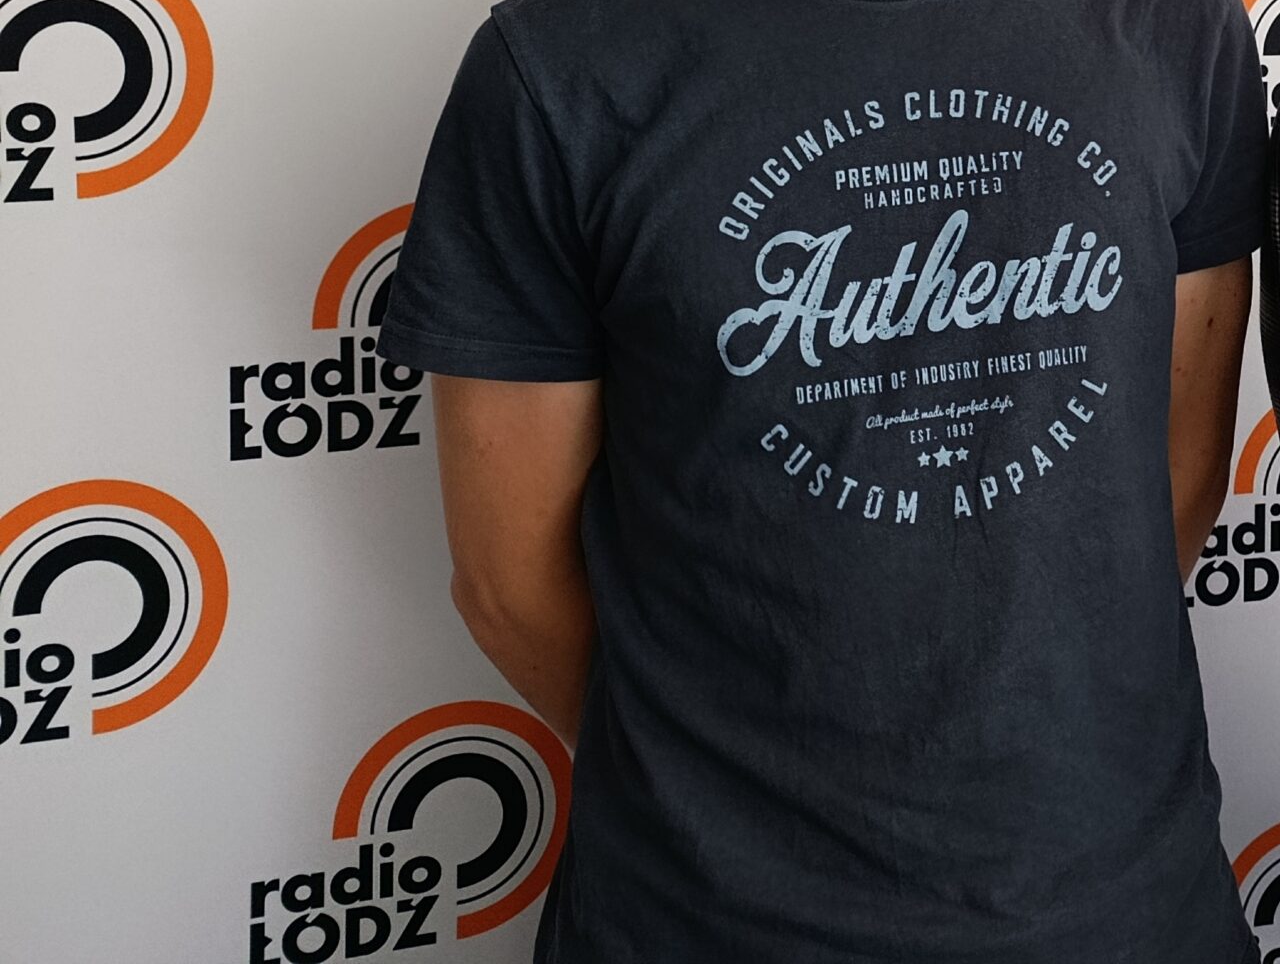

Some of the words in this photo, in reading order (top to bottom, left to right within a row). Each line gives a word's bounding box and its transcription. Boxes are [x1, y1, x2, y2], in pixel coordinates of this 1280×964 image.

[718, 100, 885, 241] ORIGINALS
[904, 88, 1070, 147] CLOTHING
[835, 160, 928, 191] PREMIUM
[938, 150, 1023, 180] QUALITY
[864, 177, 1003, 209] HANDCRAFTED
[717, 209, 1123, 377] Authentic
[796, 375, 883, 405] DEPARTMENT
[890, 370, 908, 390] OF
[915, 360, 980, 386] INDUSTRY
[987, 352, 1032, 376] FINEST
[1038, 345, 1087, 370] QUALITY
[884, 408, 920, 430] product
[921, 405, 944, 419] made
[945, 402, 956, 418] of
[956, 399, 989, 418] perfect
[990, 395, 1014, 413] style
[910, 428, 938, 444] EST.
[760, 423, 918, 524] CUSTOM
[954, 378, 1108, 519] APPAREL
[250, 842, 442, 919] radio
